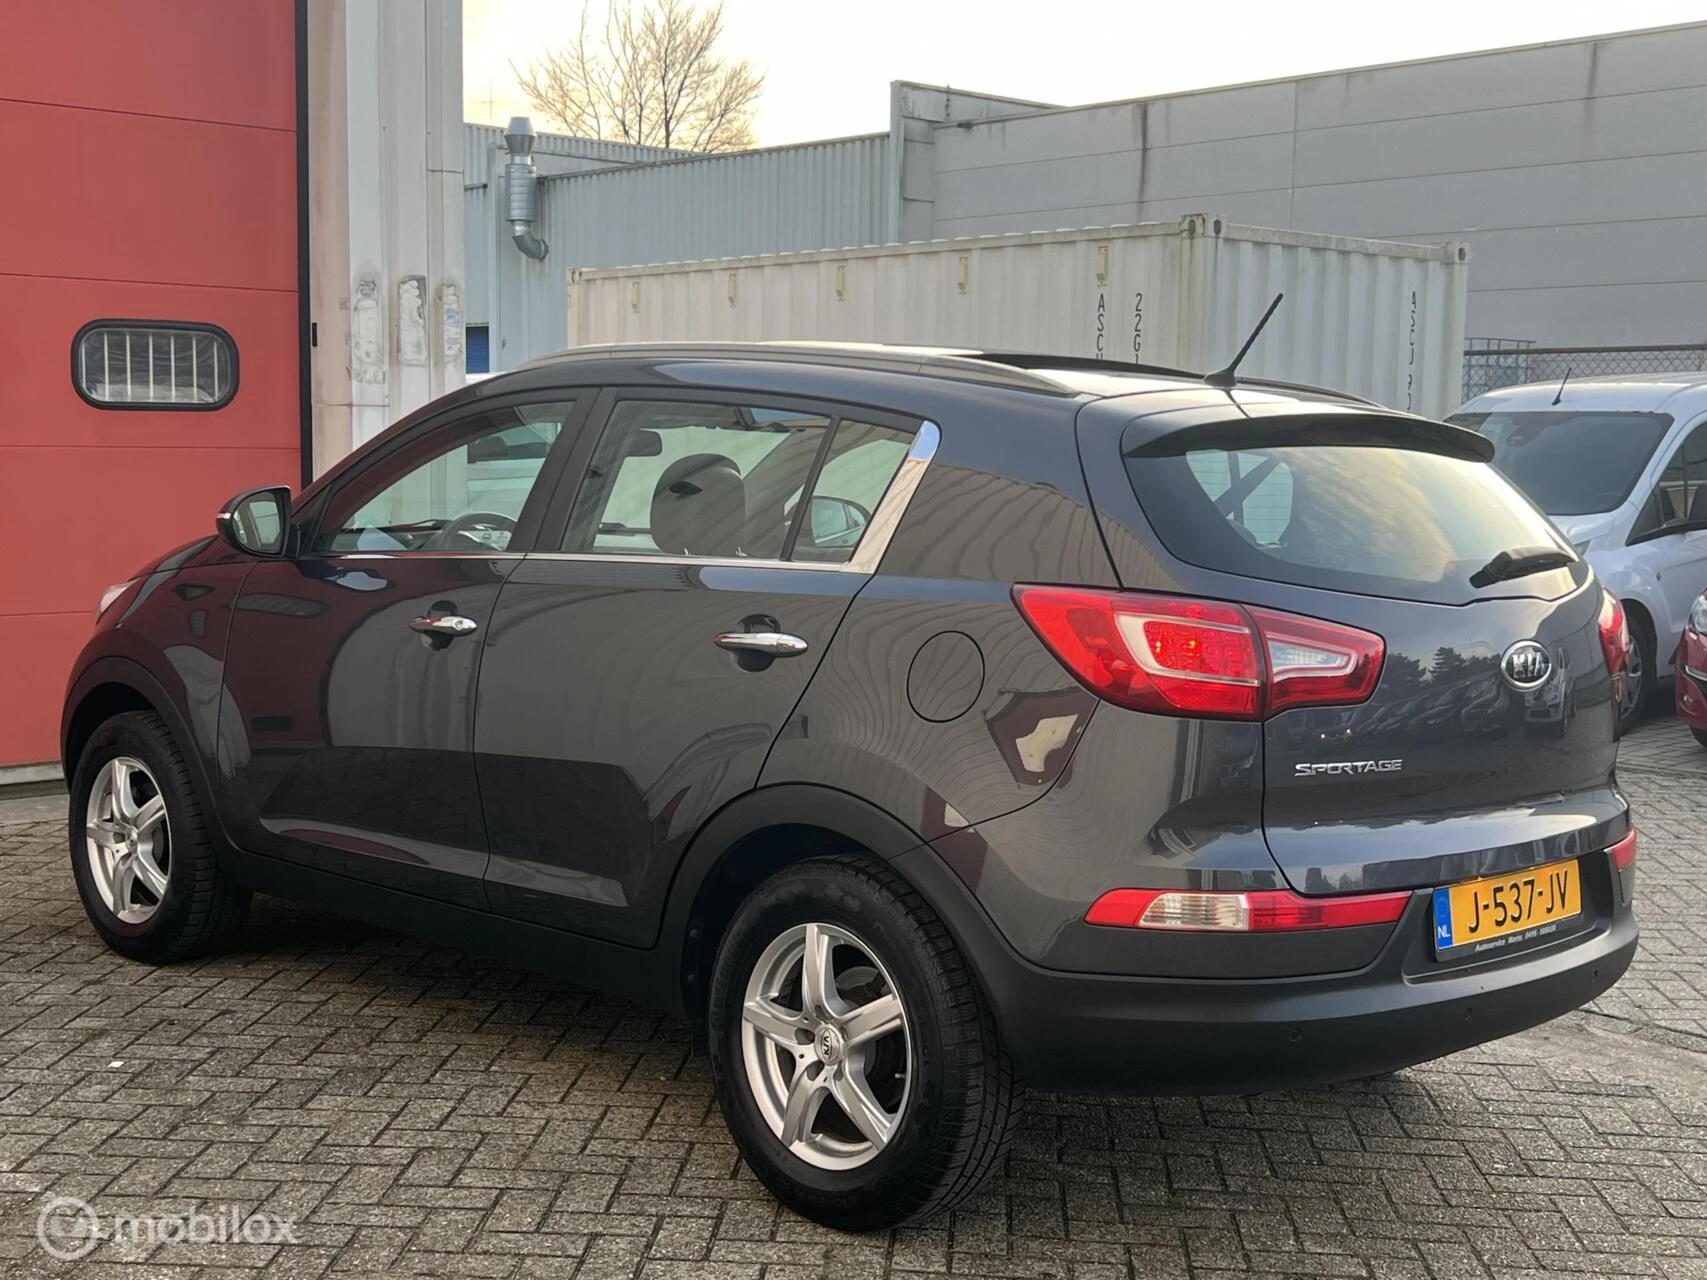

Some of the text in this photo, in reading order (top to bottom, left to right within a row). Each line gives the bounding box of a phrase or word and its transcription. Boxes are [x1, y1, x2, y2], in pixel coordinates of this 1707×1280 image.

[1511, 651, 1546, 679] KIA
[1294, 759, 1403, 777] SPORTAGE
[1468, 870, 1568, 933] J-537-JV
[1437, 925, 1451, 939] NL
